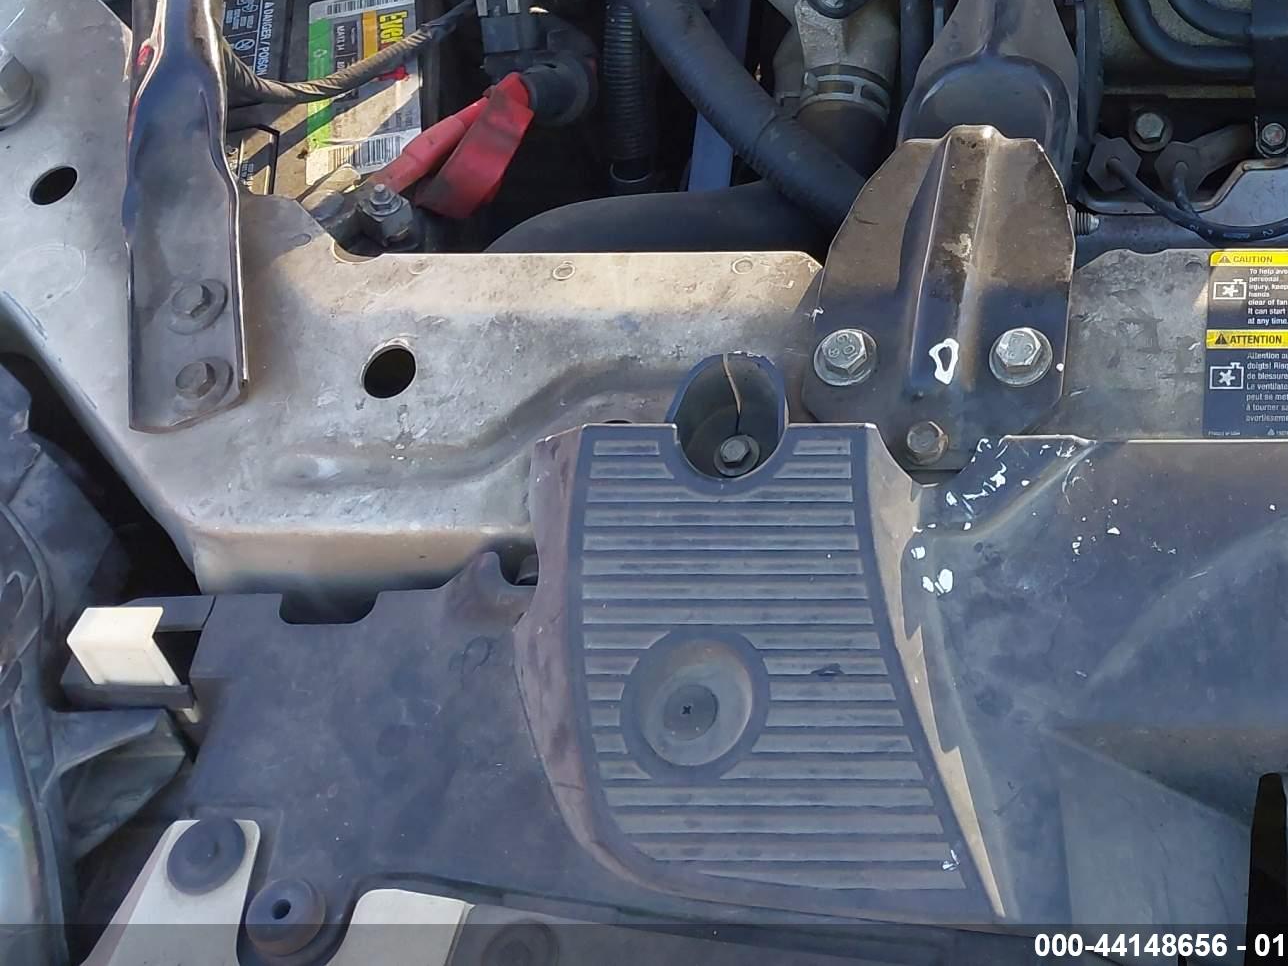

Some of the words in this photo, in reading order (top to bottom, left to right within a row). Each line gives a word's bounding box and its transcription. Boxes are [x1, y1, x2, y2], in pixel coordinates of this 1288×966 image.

[260, 8, 275, 41] DANGER
[379, 10, 408, 44] Ever
[256, 46, 270, 76] POISON
[1233, 255, 1273, 264] CAUTION
[1248, 317, 1255, 326] at
[1257, 317, 1270, 326] any
[1271, 317, 1288, 326] time.
[1230, 335, 1282, 344] ATTENTION
